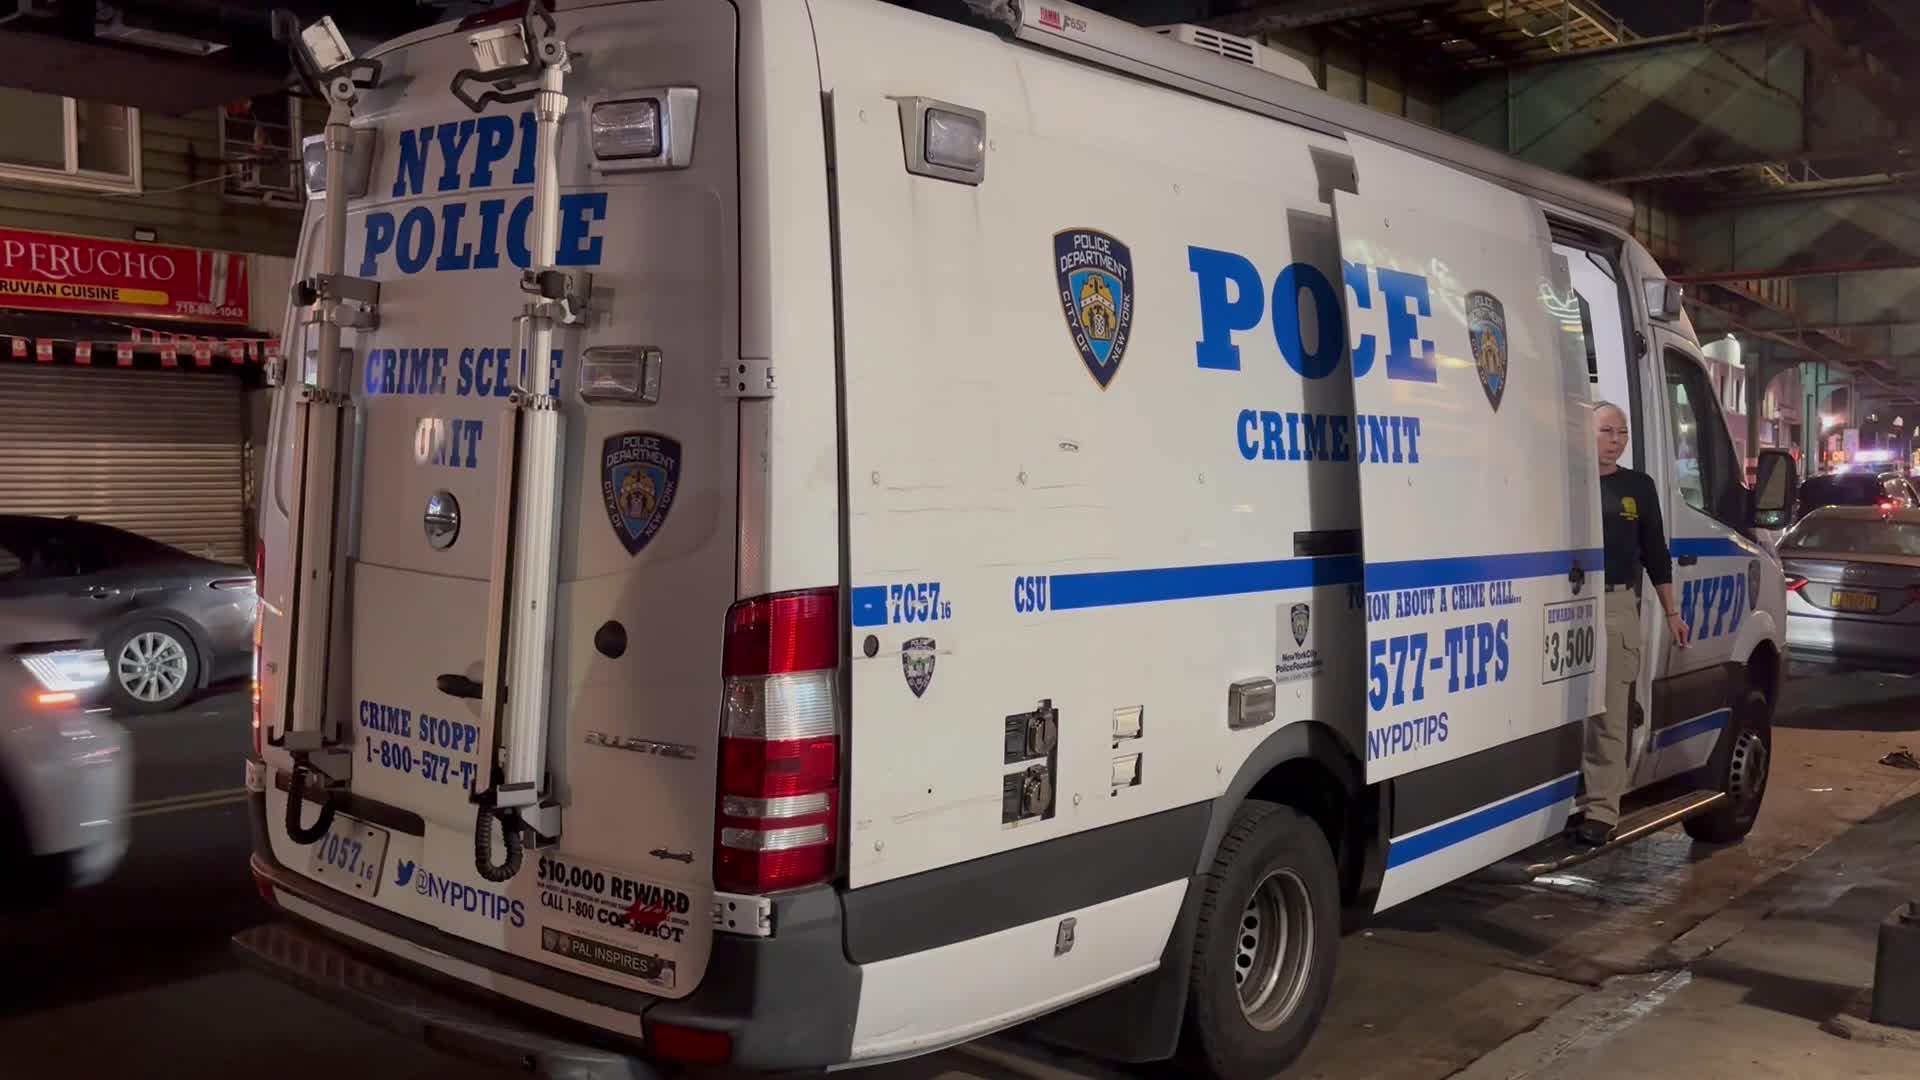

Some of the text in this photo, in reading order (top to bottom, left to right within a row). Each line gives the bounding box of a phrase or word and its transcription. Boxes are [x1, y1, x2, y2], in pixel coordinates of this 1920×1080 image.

[4, 240, 175, 281] PERUCHO
[1060, 251, 1128, 281] DEPARTMENT
[1074, 234, 1111, 255] POLICE
[60, 284, 120, 300] CUISINE
[1063, 290, 1090, 353] CITY OF
[1111, 294, 1131, 363] NEW YORK
[366, 347, 563, 399] CRIME SCEE
[606, 448, 675, 469] DEPARTMENT
[623, 436, 660, 450] POLICE
[1237, 408, 1348, 463] CRIME
[891, 582, 952, 624] 7057 16
[1014, 576, 1047, 613] CSU
[1396, 586, 1435, 618] ABOUT
[1440, 586, 1448, 615] A
[1452, 583, 1485, 611] CRIME
[1680, 572, 1746, 641] NYPD
[1368, 618, 1509, 712] 577-TIPS
[1545, 625, 1594, 676] $3,500
[360, 700, 480, 755] CRIME STOPP
[1368, 712, 1448, 762] NYPDTIPS
[415, 868, 525, 928] @NYPDTIPS
[538, 856, 605, 894] $10,000
[611, 876, 690, 914] REWARD
[541, 891, 564, 912] CALL
[568, 898, 594, 920] 1-800
[572, 941, 648, 972] PAL INSPIRES
